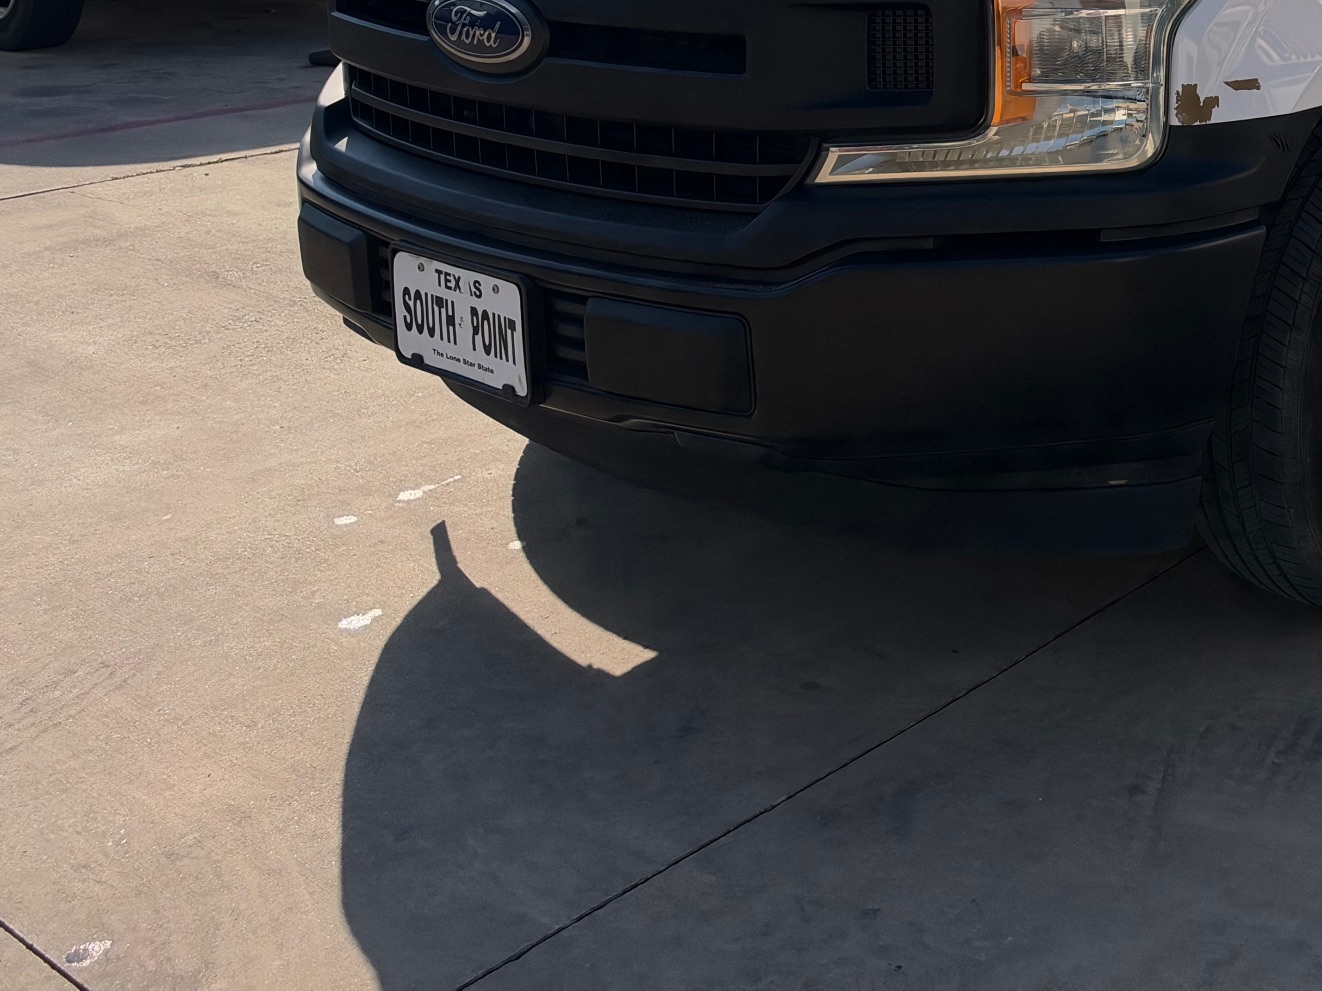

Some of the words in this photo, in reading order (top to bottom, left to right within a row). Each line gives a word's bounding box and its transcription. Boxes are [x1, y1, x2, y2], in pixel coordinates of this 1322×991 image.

[446, 5, 502, 48] Ford
[402, 286, 458, 346] SOUTH
[469, 305, 517, 366] POINT
[432, 348, 445, 358] The
[445, 352, 462, 363] Lone
[462, 358, 476, 369] Star
[477, 362, 495, 375] State
